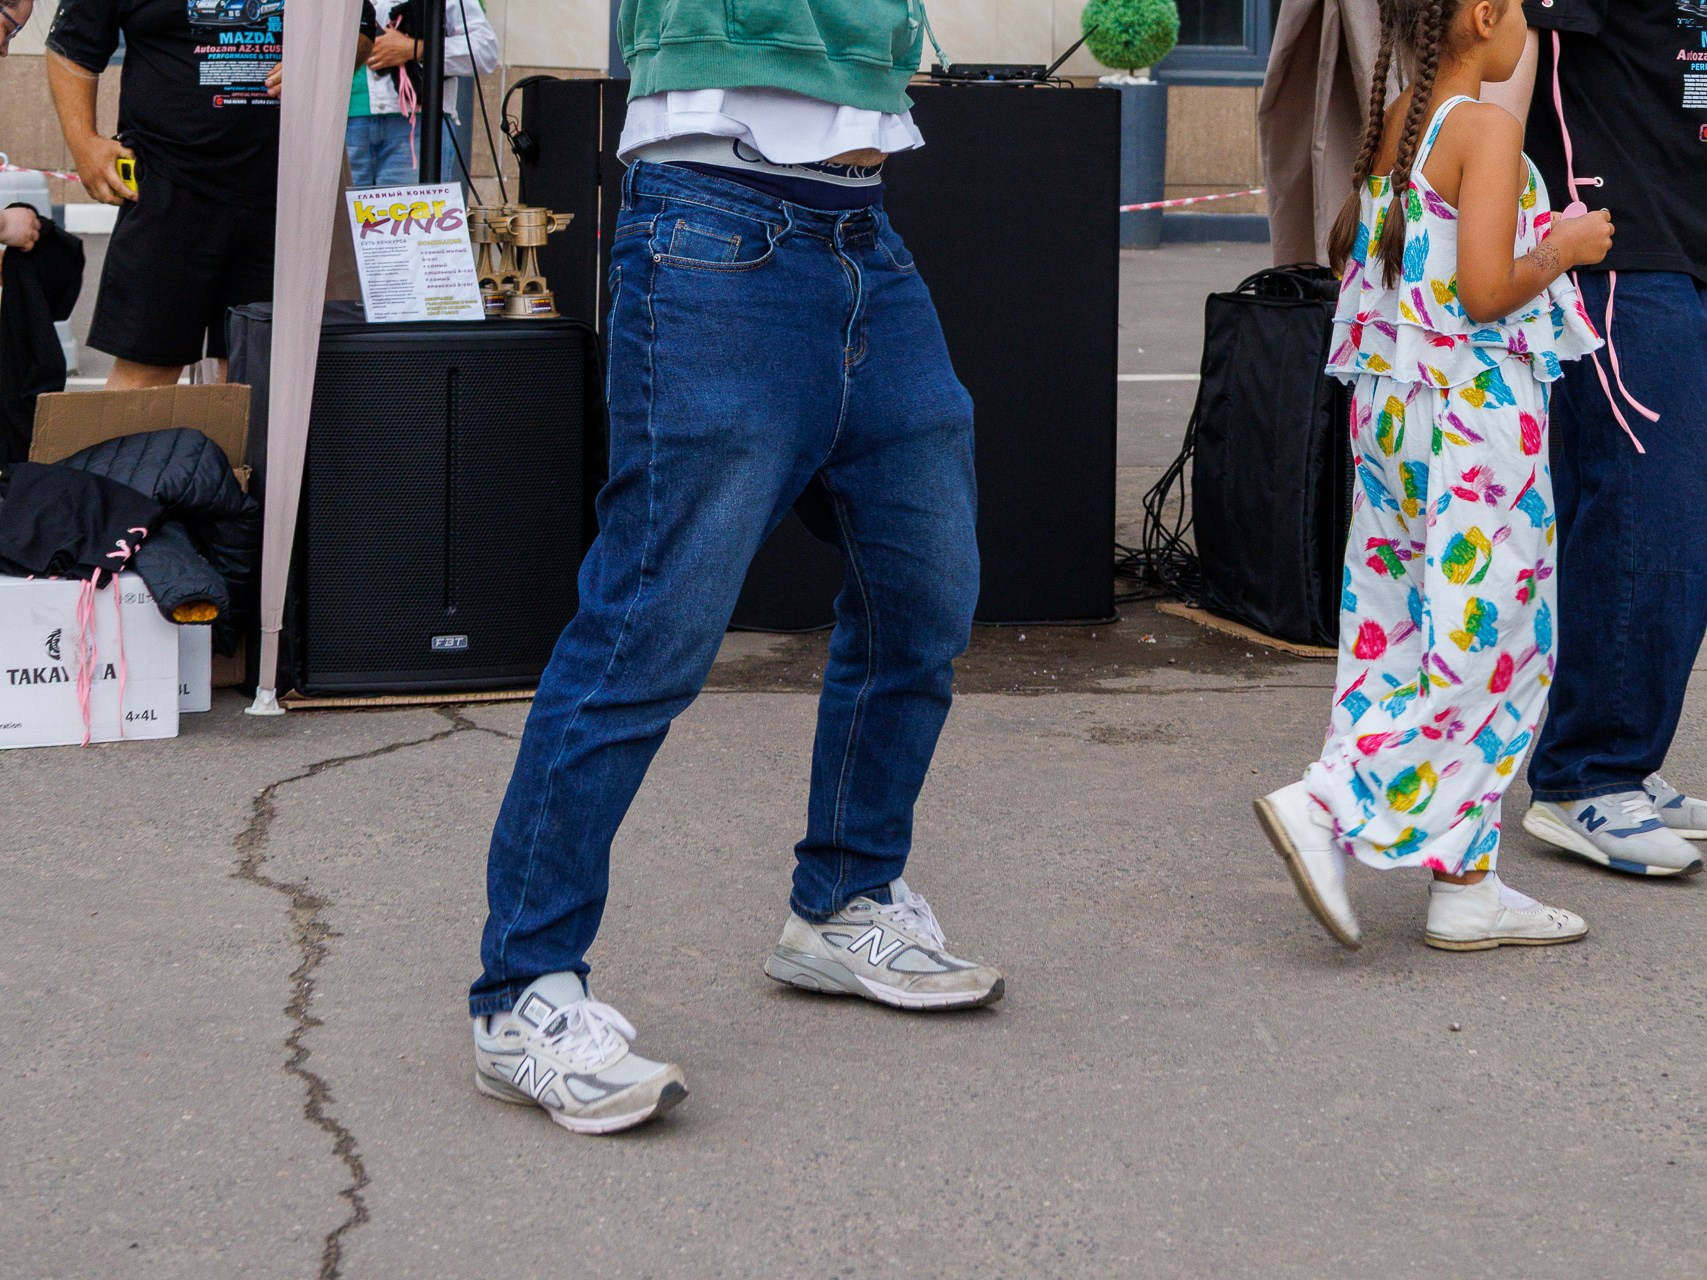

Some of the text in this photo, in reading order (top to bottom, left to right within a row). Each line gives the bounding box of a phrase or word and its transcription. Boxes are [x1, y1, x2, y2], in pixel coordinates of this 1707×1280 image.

[194, 44, 283, 54] Autozam AZ-1 CUS
[219, 31, 275, 44] MAZDA
[358, 188, 450, 200] ГЛАВНЫЙ КОНКУРС
[353, 200, 446, 224] k-car
[360, 208, 463, 239] KING
[434, 637, 465, 648] FBT
[1576, 804, 1609, 834] N
[847, 925, 906, 967] N
[512, 1055, 558, 1100] N
